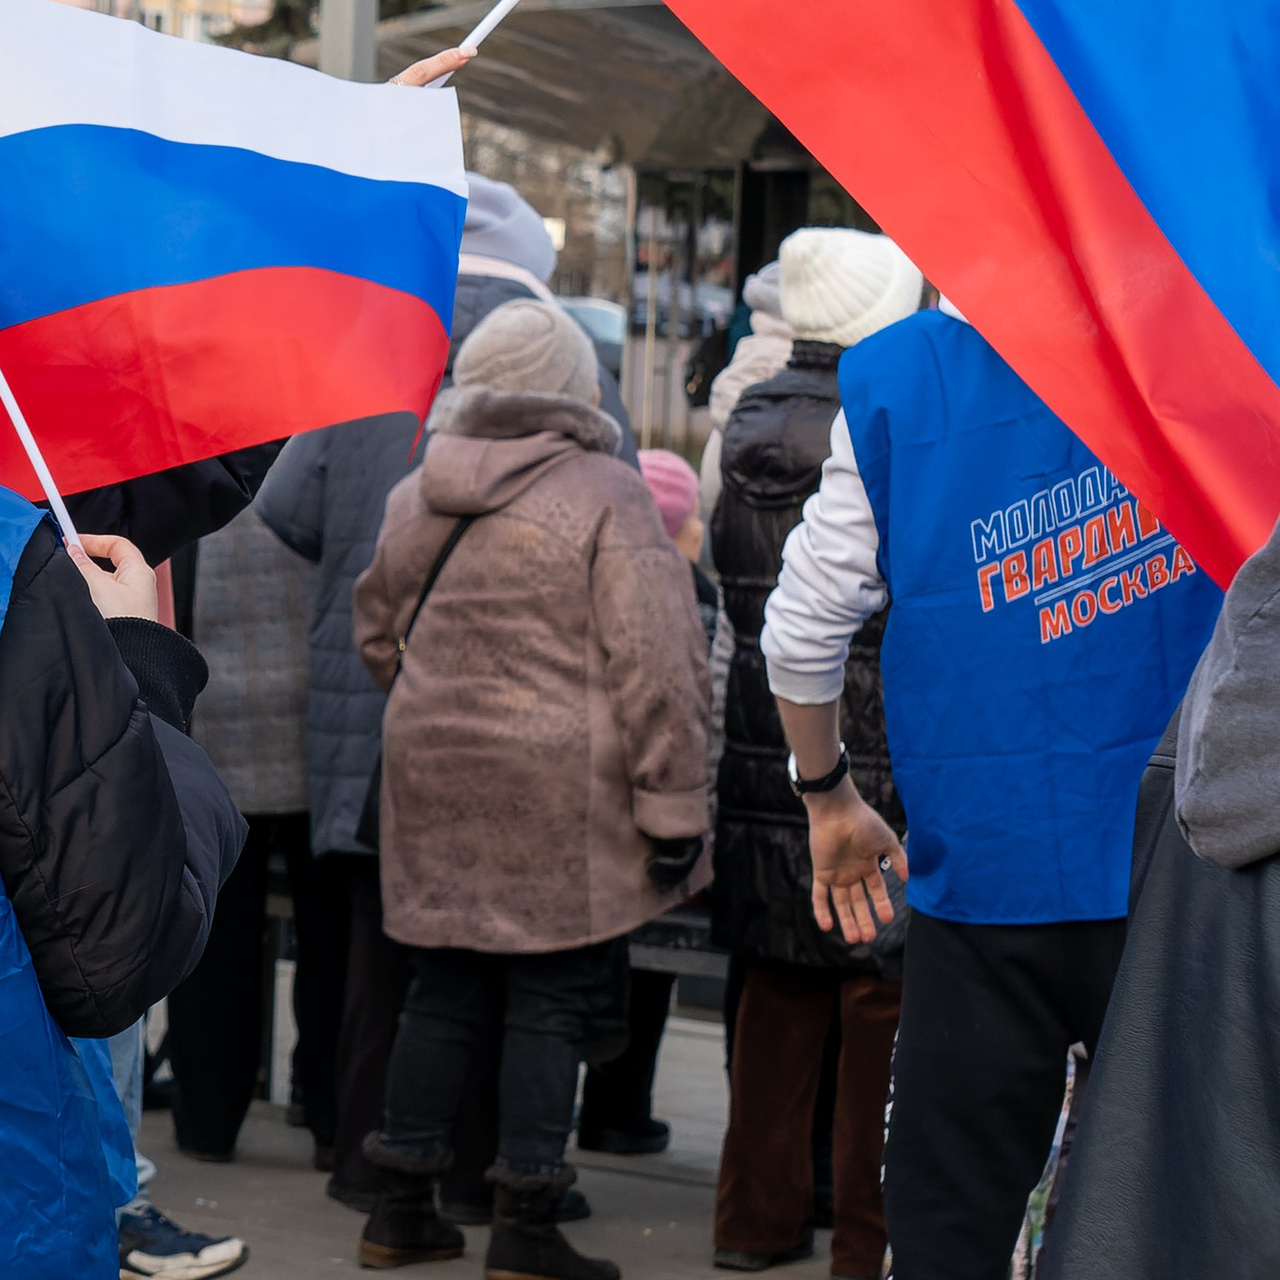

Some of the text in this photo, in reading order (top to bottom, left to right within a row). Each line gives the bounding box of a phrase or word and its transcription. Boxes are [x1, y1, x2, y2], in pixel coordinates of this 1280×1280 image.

[971, 465, 1160, 564] МОЛОДА
[977, 499, 1161, 613] ГВАРДИ
[1039, 544, 1197, 645] МОСКВА
